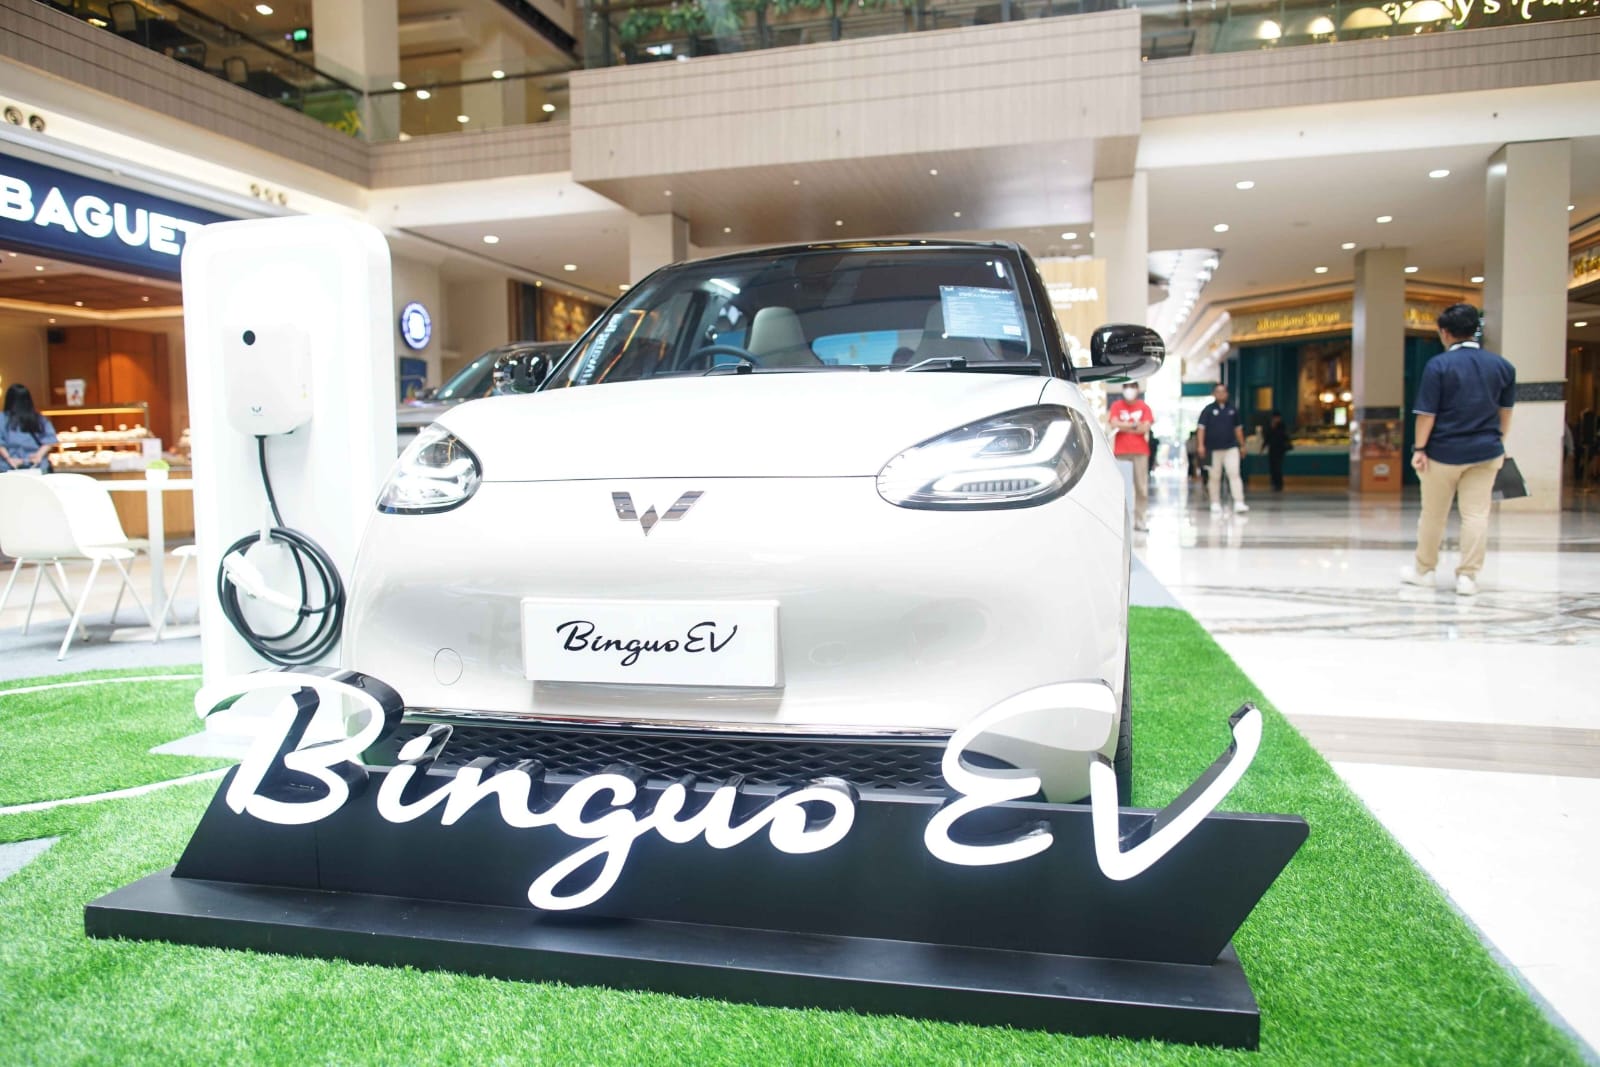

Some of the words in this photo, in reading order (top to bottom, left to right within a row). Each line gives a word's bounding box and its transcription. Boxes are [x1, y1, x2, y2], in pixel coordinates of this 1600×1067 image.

[556, 620, 679, 666] Binguo
[684, 621, 738, 652] EV
[195, 669, 857, 911] Binguo
[925, 681, 1263, 881] EV
